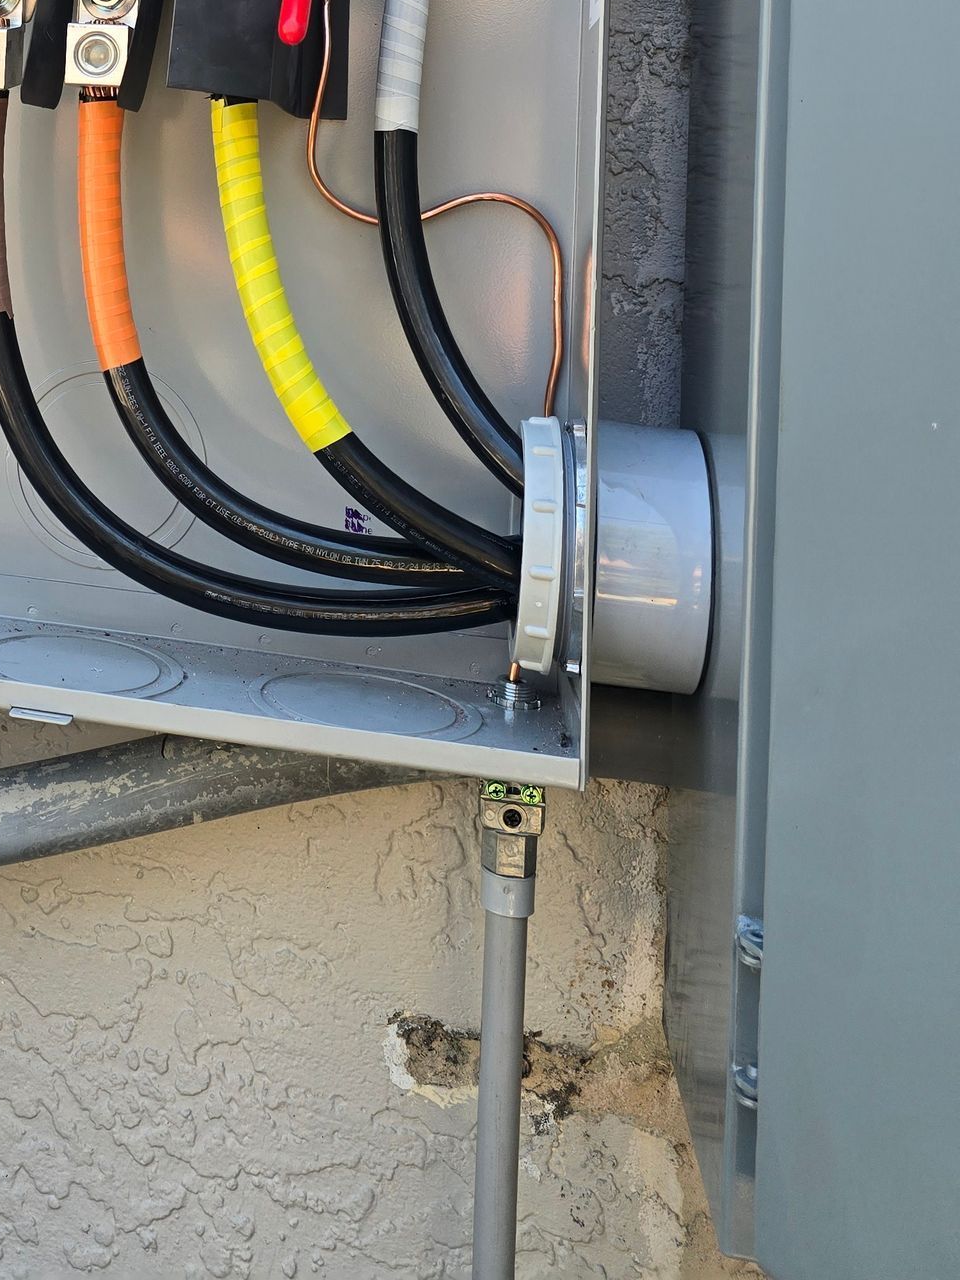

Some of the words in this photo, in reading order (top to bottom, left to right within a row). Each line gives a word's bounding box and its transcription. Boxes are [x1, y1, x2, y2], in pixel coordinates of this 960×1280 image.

[145, 425, 157, 442] FT4
[153, 441, 168, 460] IEEE
[165, 459, 180, 475] 1202
[178, 472, 194, 488] 600V
[192, 486, 207, 502] FOR
[205, 498, 216, 509] CT
[280, 537, 300, 550] TYPE
